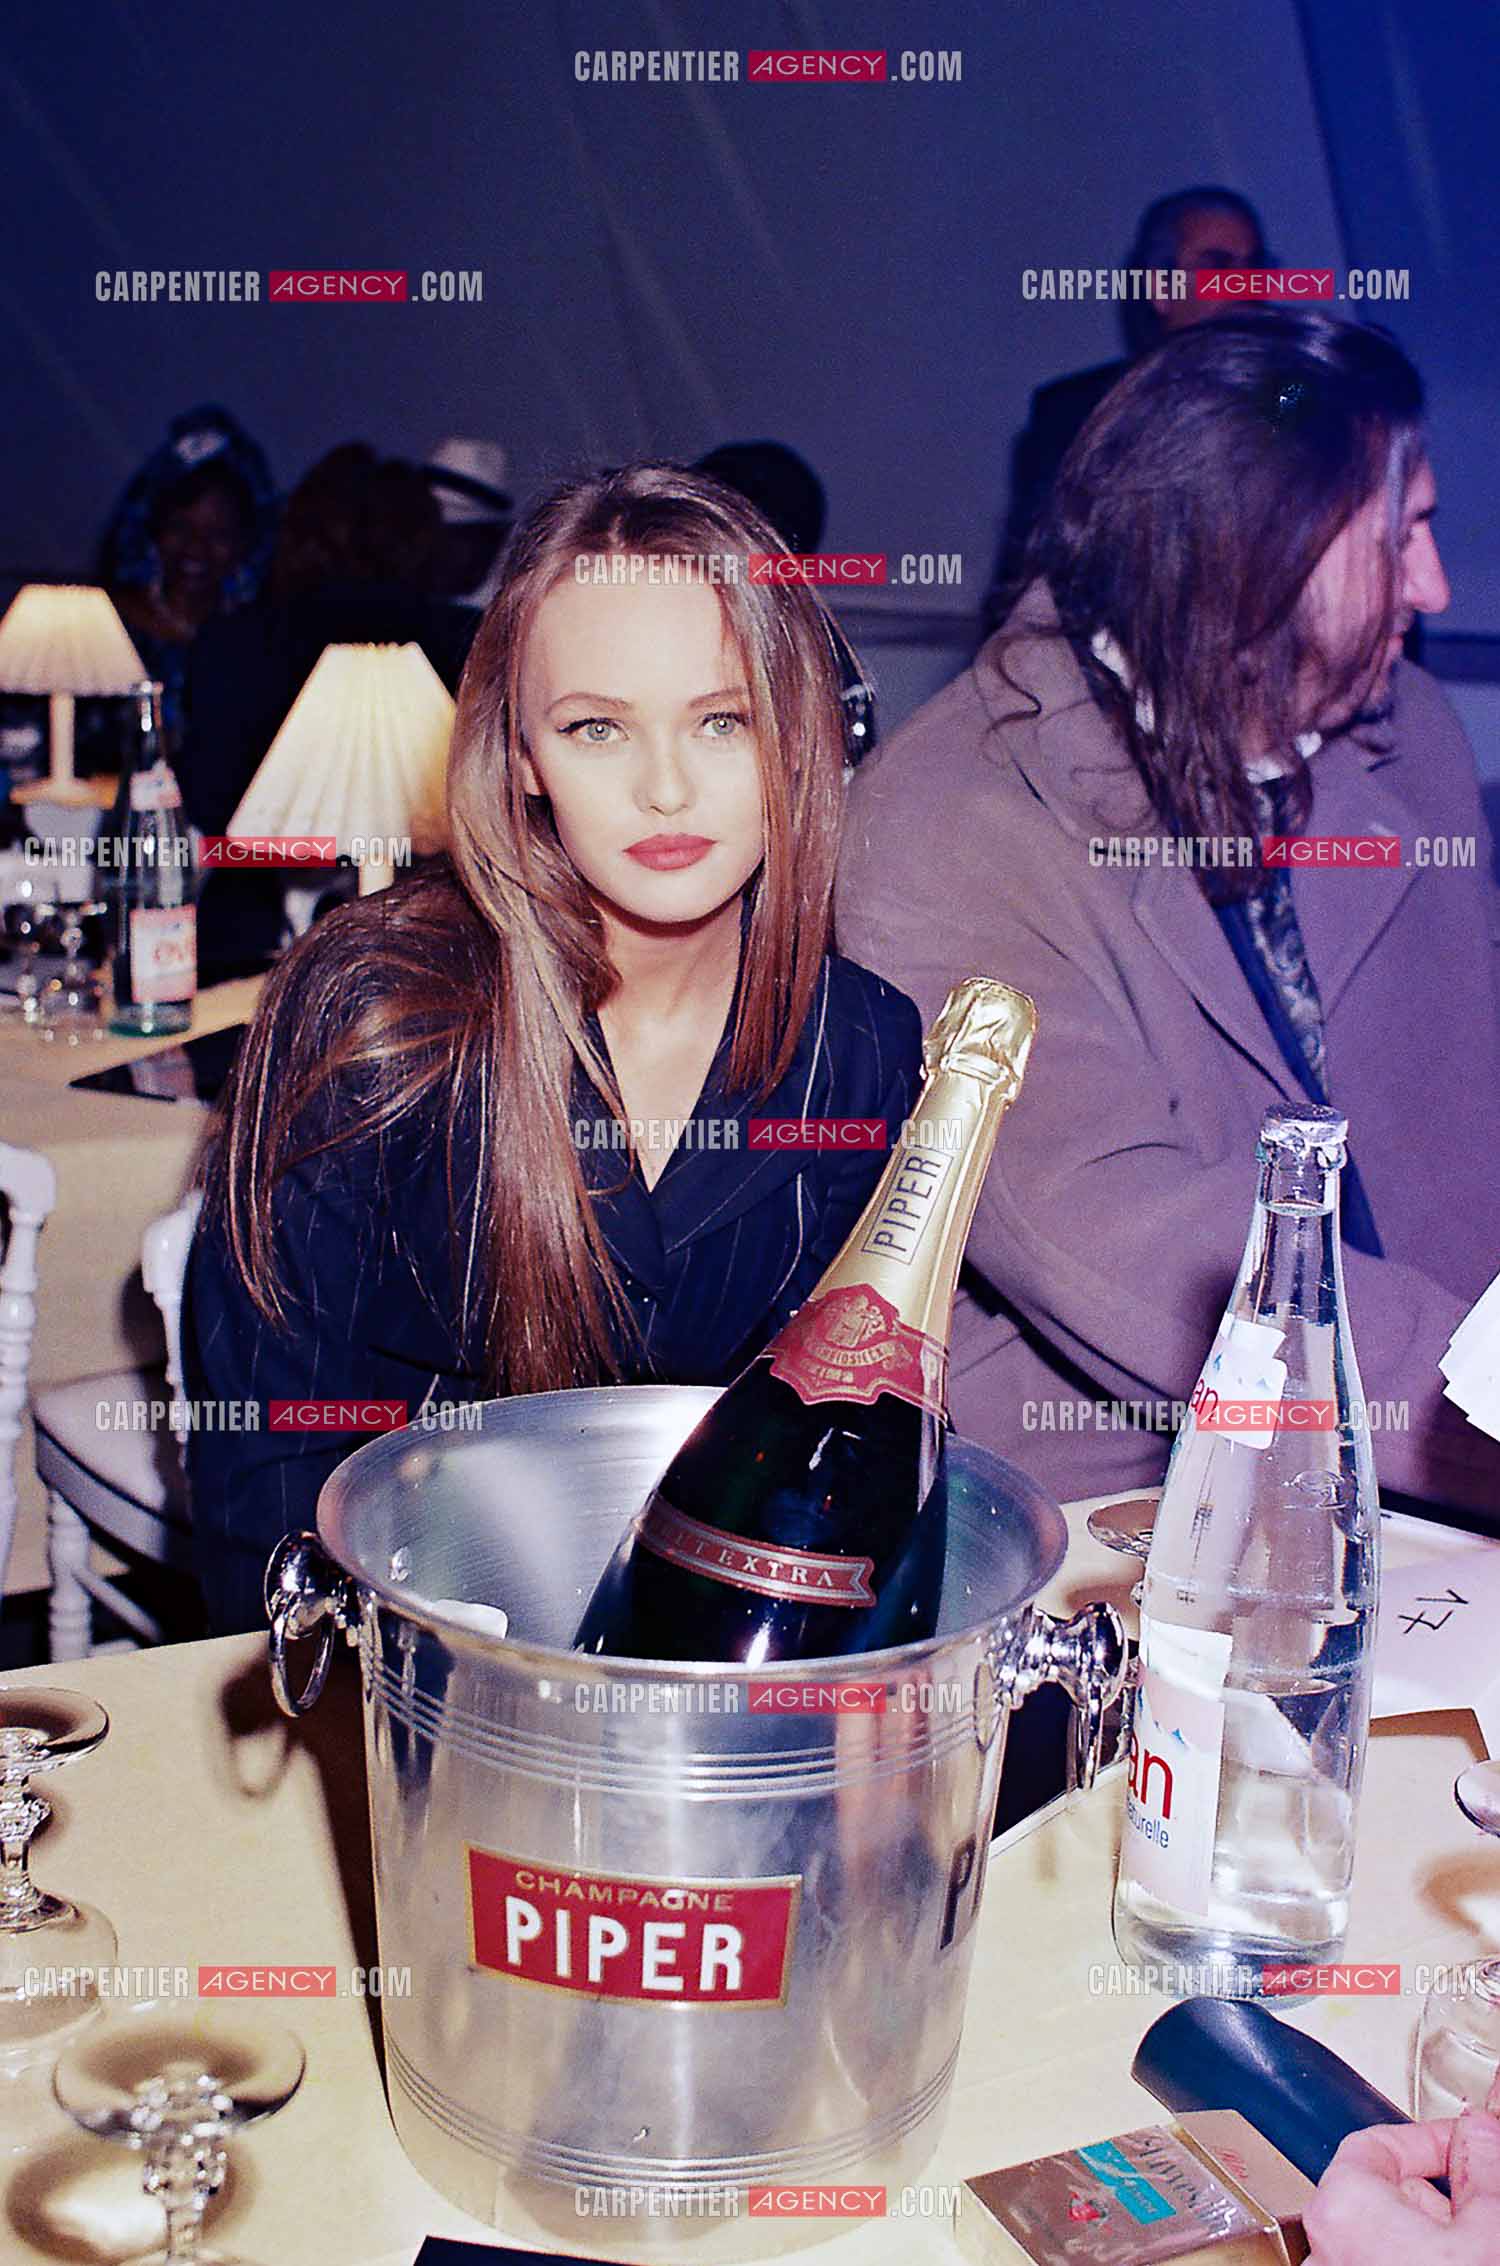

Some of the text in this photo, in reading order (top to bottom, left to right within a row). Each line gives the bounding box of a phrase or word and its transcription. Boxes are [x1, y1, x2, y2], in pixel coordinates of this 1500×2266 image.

[872, 1155, 941, 1252] PIPER
[719, 1549, 834, 1588] EXTRA
[514, 1870, 735, 1912] CHAMPAGNE
[505, 1895, 744, 1992] PIPER
